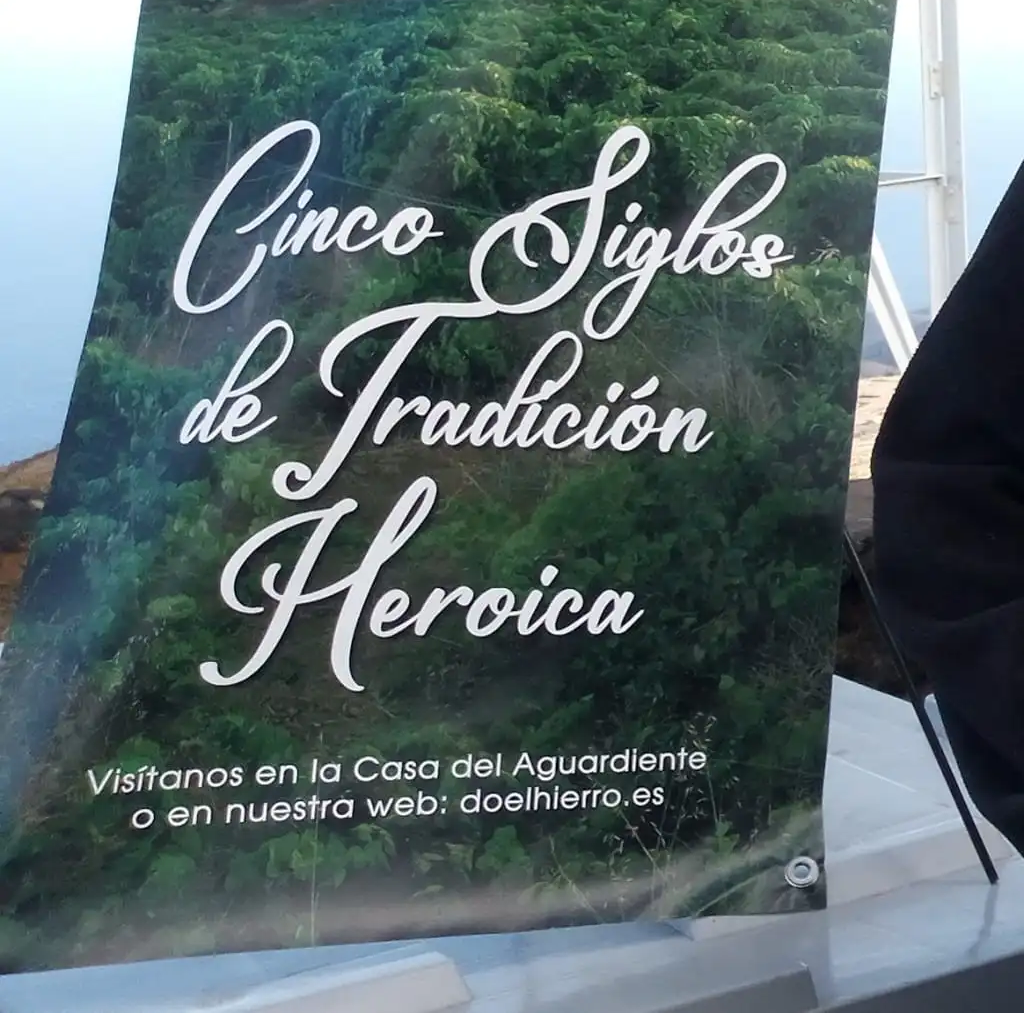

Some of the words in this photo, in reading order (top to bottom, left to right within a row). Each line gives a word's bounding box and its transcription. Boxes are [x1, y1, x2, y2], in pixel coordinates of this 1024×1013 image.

[172, 120, 444, 314] Cinco
[469, 124, 795, 340] Siglos
[179, 319, 294, 445] de
[271, 300, 714, 500] Tradición
[199, 476, 644, 692] Heroica
[87, 765, 244, 795] Visítanos
[255, 764, 298, 785] en
[311, 758, 341, 783] la
[353, 756, 440, 783] Casa
[451, 752, 502, 779] del
[512, 747, 707, 781] Aguardiente
[132, 808, 155, 829] o
[167, 804, 212, 827] en
[225, 798, 354, 825] nuestra
[366, 790, 447, 817] web:
[460, 784, 664, 814] doelhierro.es
